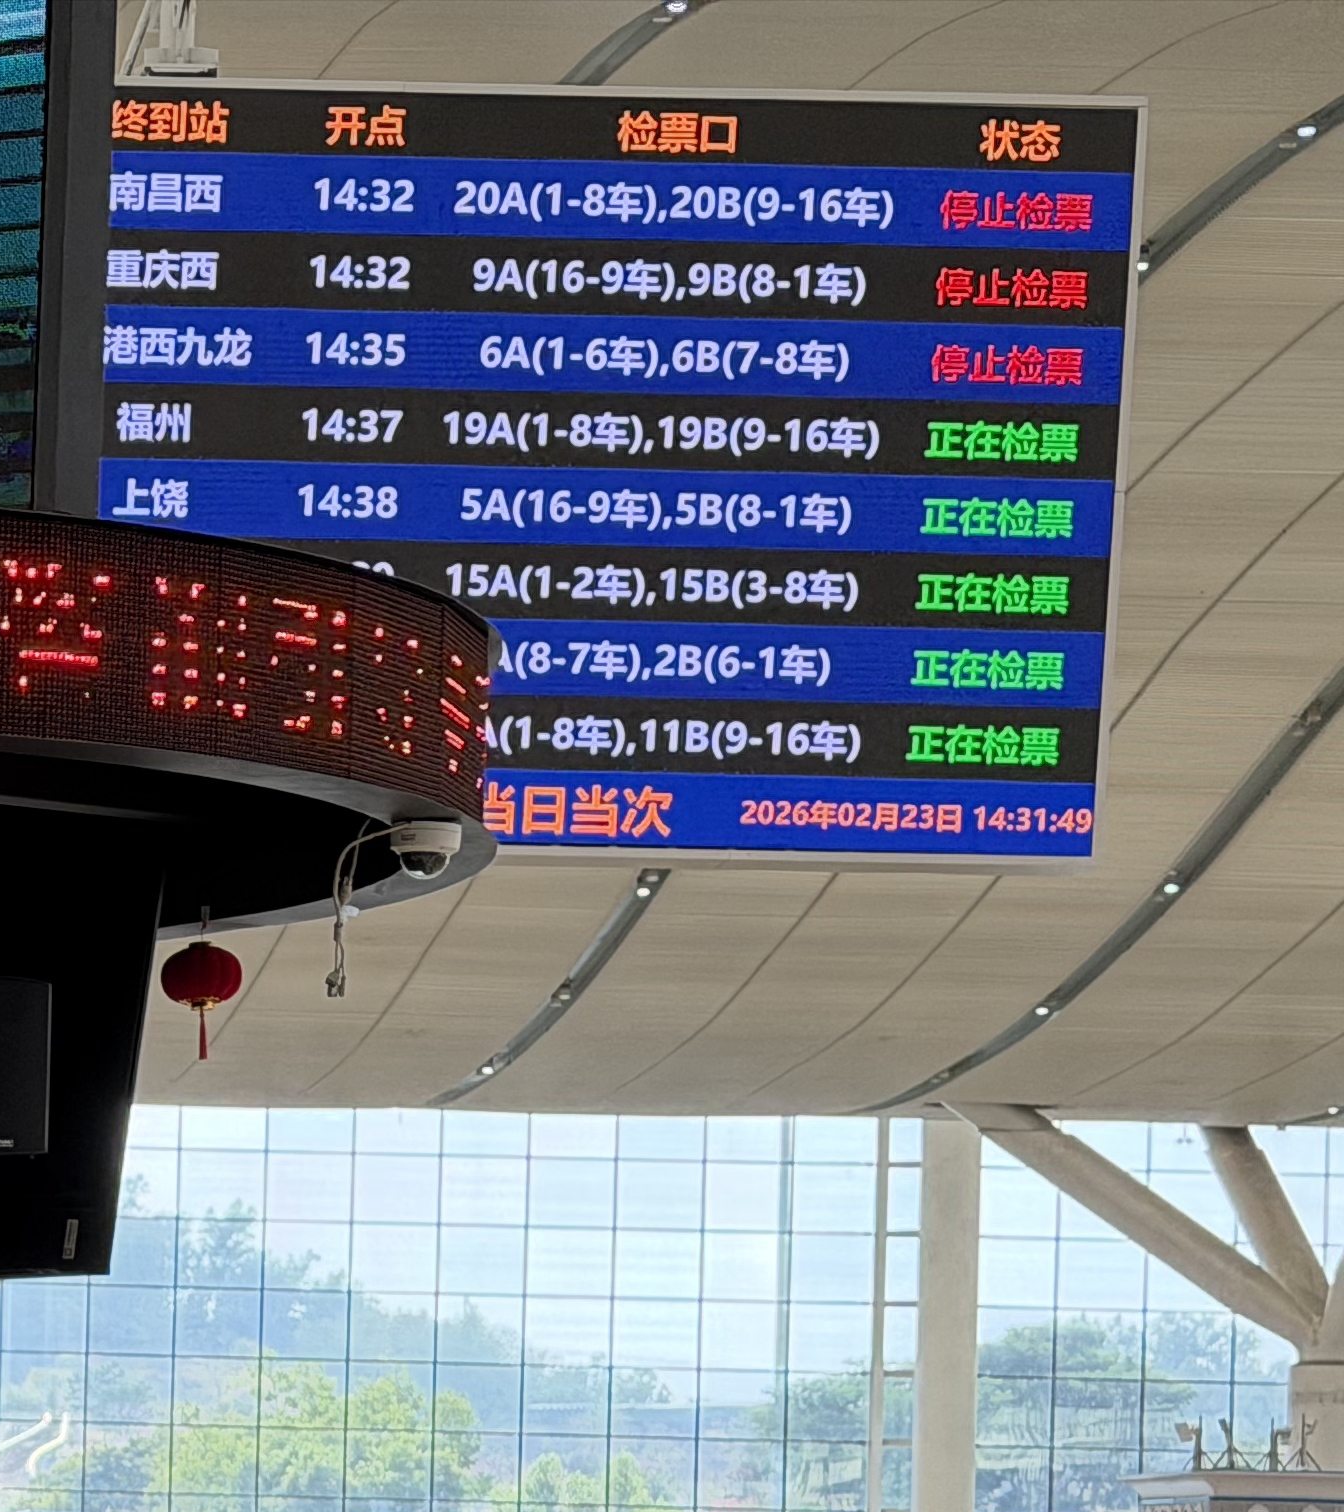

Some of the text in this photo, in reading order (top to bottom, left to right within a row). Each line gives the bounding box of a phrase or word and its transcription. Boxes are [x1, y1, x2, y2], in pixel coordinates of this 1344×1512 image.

[111, 99, 1062, 162] 终到站 开点 检票口 状态
[108, 170, 1093, 232] 南昌西 14:32 20A(1-8车),20B(9-16车) 停止检票
[105, 248, 1088, 310] 重庆西 14:32 9A(16-9车),9B(8-1车) 停止检票
[306, 331, 406, 367] 14:35
[480, 335, 850, 383] 6A(1-6车),6B(7-8车)
[931, 344, 1084, 386] 停止检票
[116, 401, 1079, 463] 福州 14:37 19A(1-8车),19B(9-16车) 正在检票
[112, 478, 1074, 539] 上饶 14:38 5A(16-9车),5B(8-1车) 正在检票
[445, 563, 859, 612] 15A(1-2车),15B(3-8车)
[914, 572, 1070, 615] 正在检票
[910, 648, 1065, 691] 正在检票
[905, 724, 1060, 767] 正在检票
[484, 781, 1093, 838] 当日当次 2026年02月23日 14:31:49
